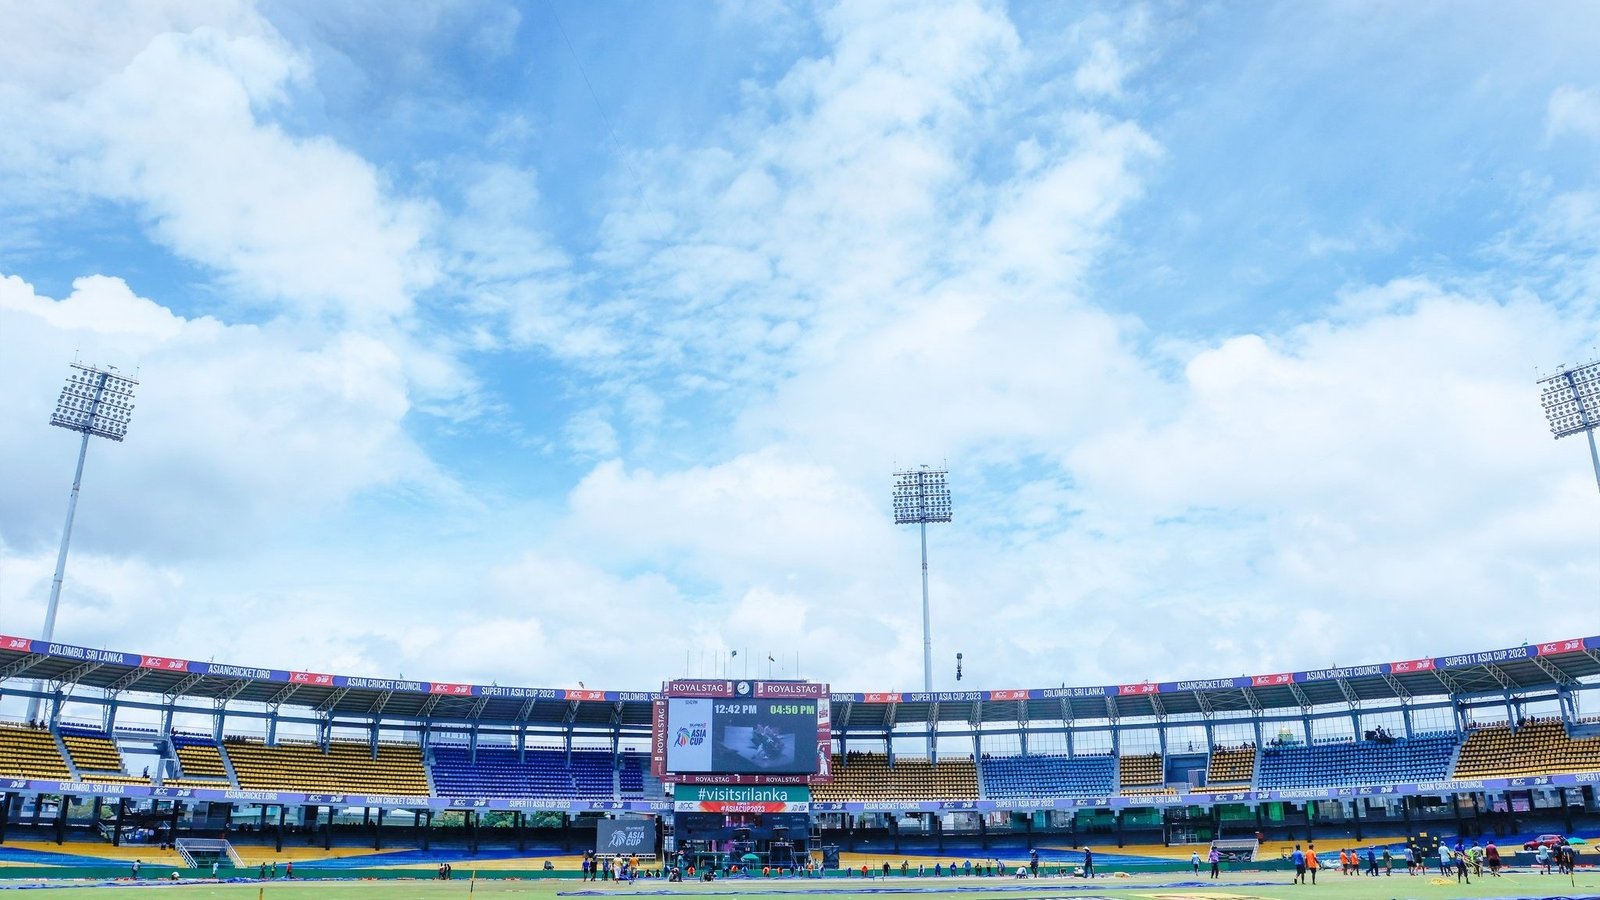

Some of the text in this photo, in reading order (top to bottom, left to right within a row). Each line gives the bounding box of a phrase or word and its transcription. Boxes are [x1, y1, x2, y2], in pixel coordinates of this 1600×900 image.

[49, 644, 124, 663] COLOMBO, SRI LANKA
[1446, 648, 1527, 666] SUPER11 ASIA CUP 2023
[208, 665, 270, 679] ASIANCRICKET.ORG
[1306, 667, 1382, 680] ASIAN CRICKET COUNCIL
[347, 678, 422, 691] ASIAN CRICKET COUNCIL
[1177, 679, 1233, 691] ASIANCRICKET.ORG
[482, 686, 555, 698] SUPER11 ASIA CUP 2023
[620, 692, 650, 701] COLOMBO,
[912, 692, 981, 702] SUPER11 ASIA CUP 2023
[1044, 687, 1105, 698] COLOMBO, SRI LANKA
[832, 694, 856, 702] COUNCIL
[715, 705, 757, 714] 12:42 PM
[770, 705, 814, 714] 04:50 PM
[1575, 773, 1600, 782] SUPER1
[60, 783, 124, 794] COLOMBO, SRI LANKA
[1435, 781, 1458, 790] CRICKET
[225, 791, 277, 800] ASIANCRICKET.ORG
[698, 788, 788, 801] #visitsrilanka
[1280, 789, 1328, 798] ASIANCRICKET.ORG
[383, 797, 405, 805] CRICKET
